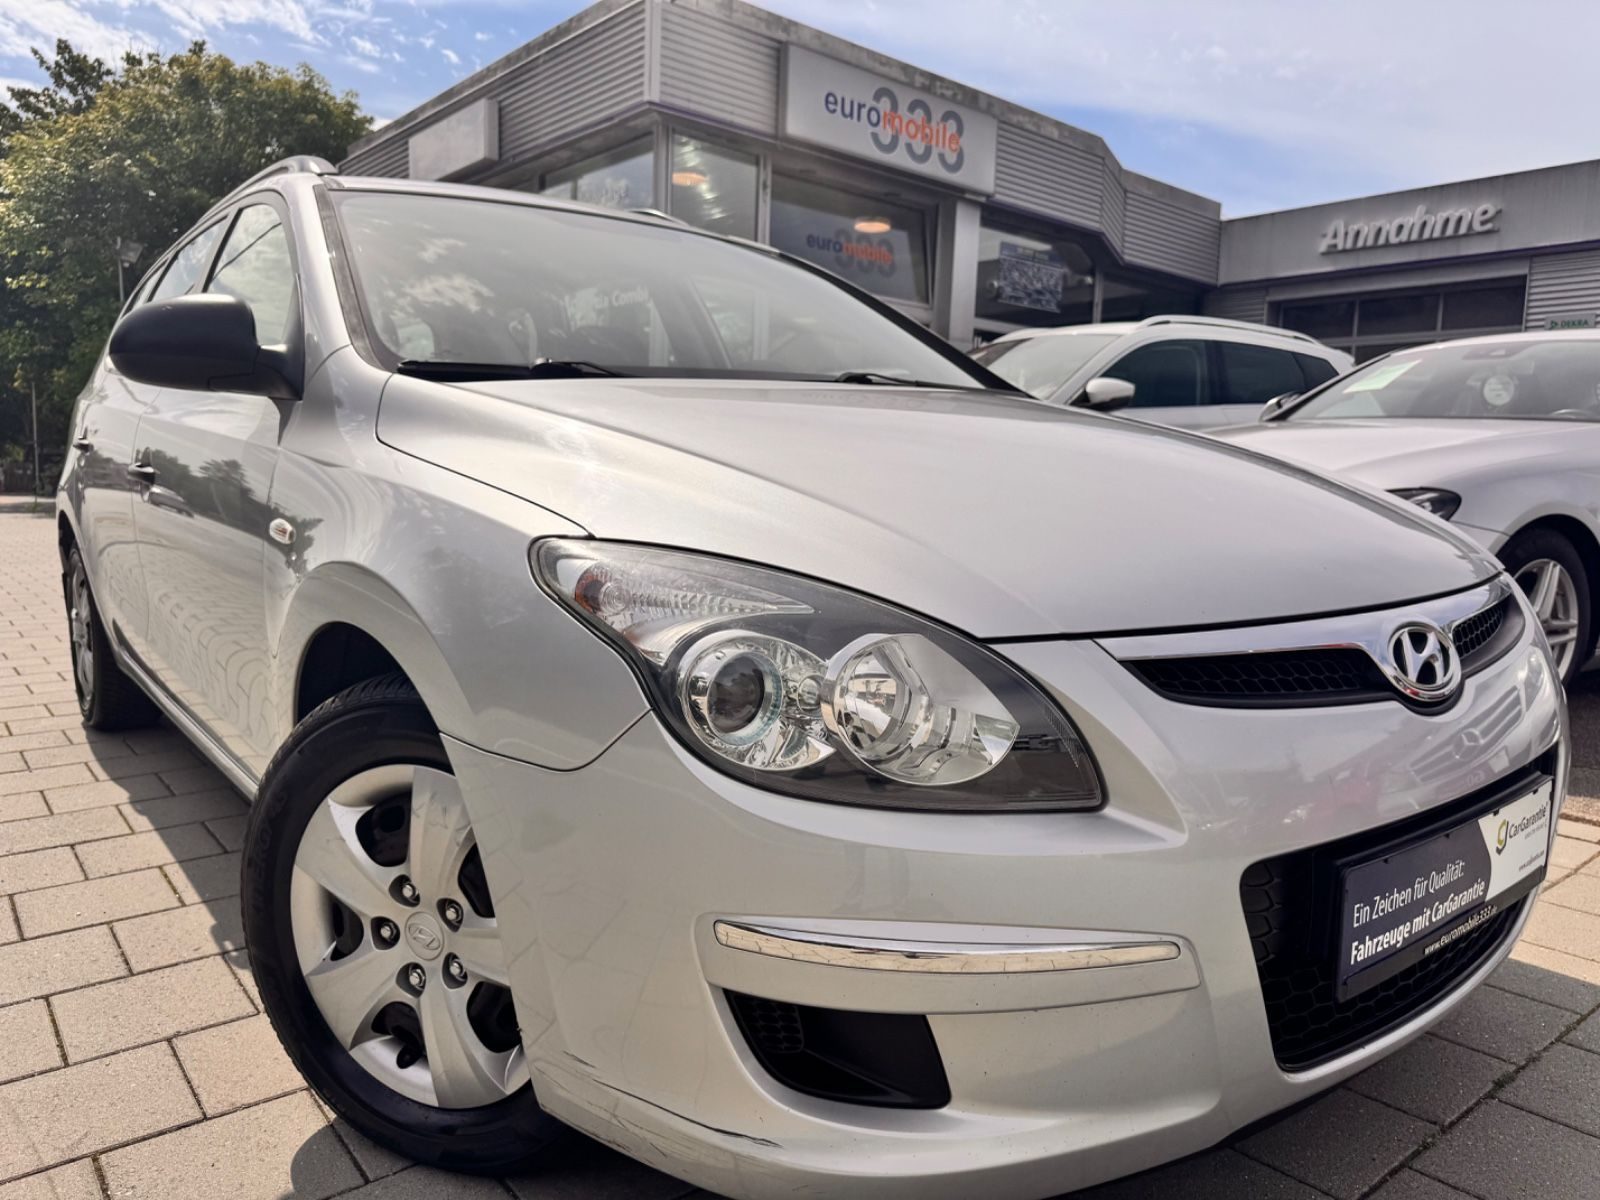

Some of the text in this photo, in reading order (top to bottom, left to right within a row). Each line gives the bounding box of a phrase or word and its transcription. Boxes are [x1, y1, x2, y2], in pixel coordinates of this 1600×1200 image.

[870, 86, 965, 174] 333
[1318, 203, 1498, 253] Annahme
[1350, 878, 1486, 965] Fahrzeuge mit CarGarantie
[1353, 903, 1371, 928] Ein
[1372, 887, 1412, 920] Zeichen
[1413, 876, 1429, 901] für
